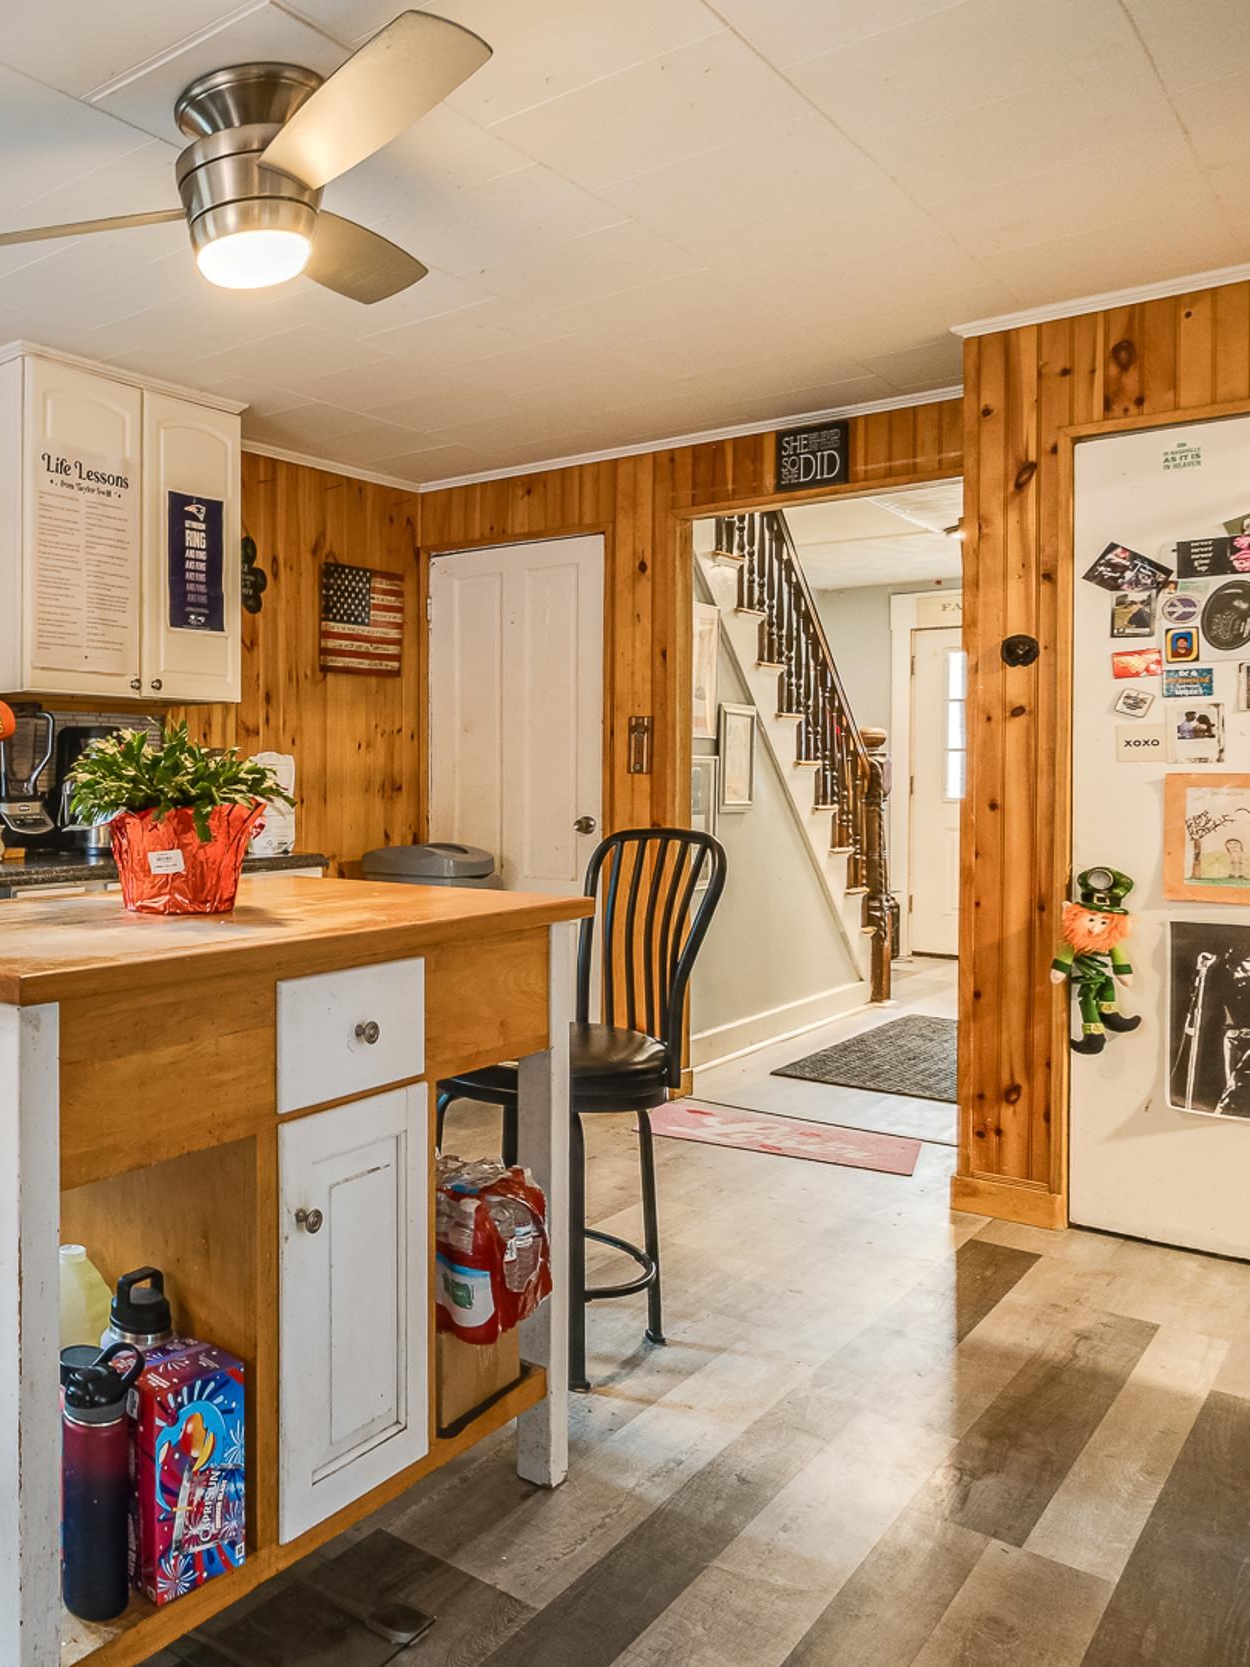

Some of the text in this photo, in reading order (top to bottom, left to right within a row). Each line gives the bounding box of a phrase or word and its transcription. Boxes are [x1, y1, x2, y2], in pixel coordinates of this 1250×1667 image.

[781, 434, 808, 456] SHE
[41, 452, 129, 489] Life Lessons
[781, 456, 799, 472] SO
[799, 450, 841, 482] DID
[184, 529, 206, 548] RING
